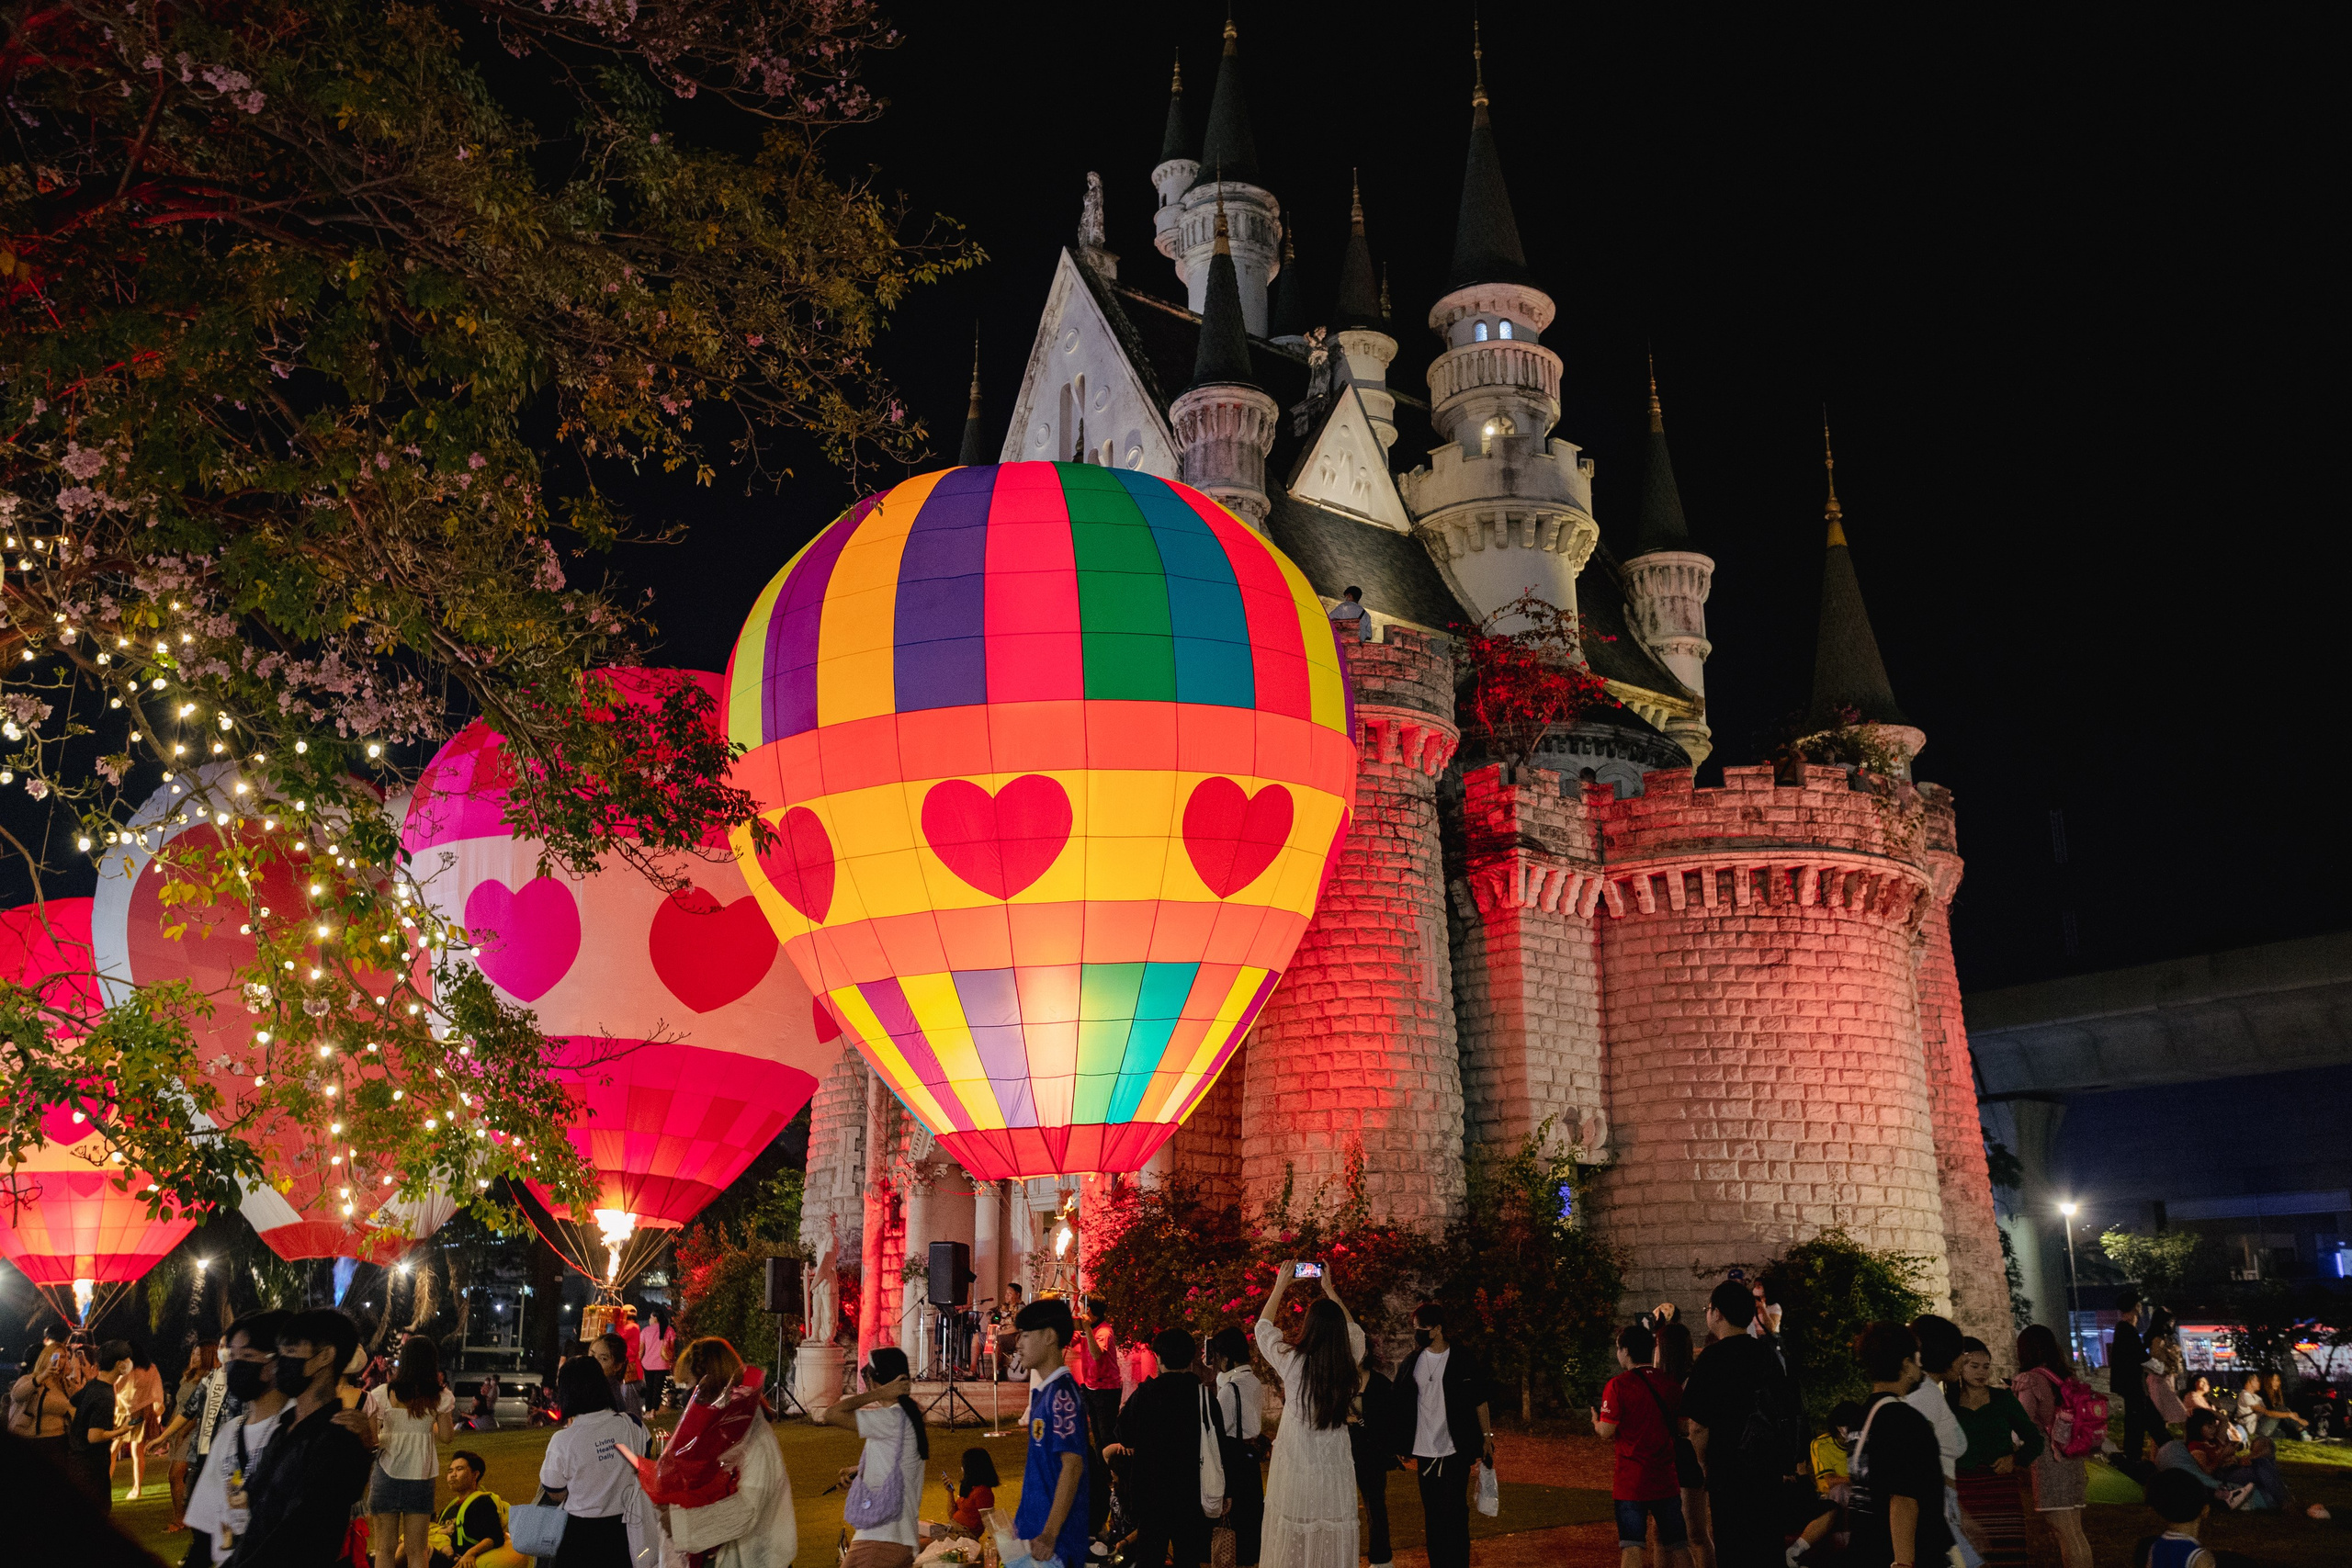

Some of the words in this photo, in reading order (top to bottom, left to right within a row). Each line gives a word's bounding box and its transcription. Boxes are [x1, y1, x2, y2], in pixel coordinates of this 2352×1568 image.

[203, 1383, 225, 1438] BANGTAN
[594, 1438, 616, 1448] Living
[598, 1452, 615, 1461] Daily
